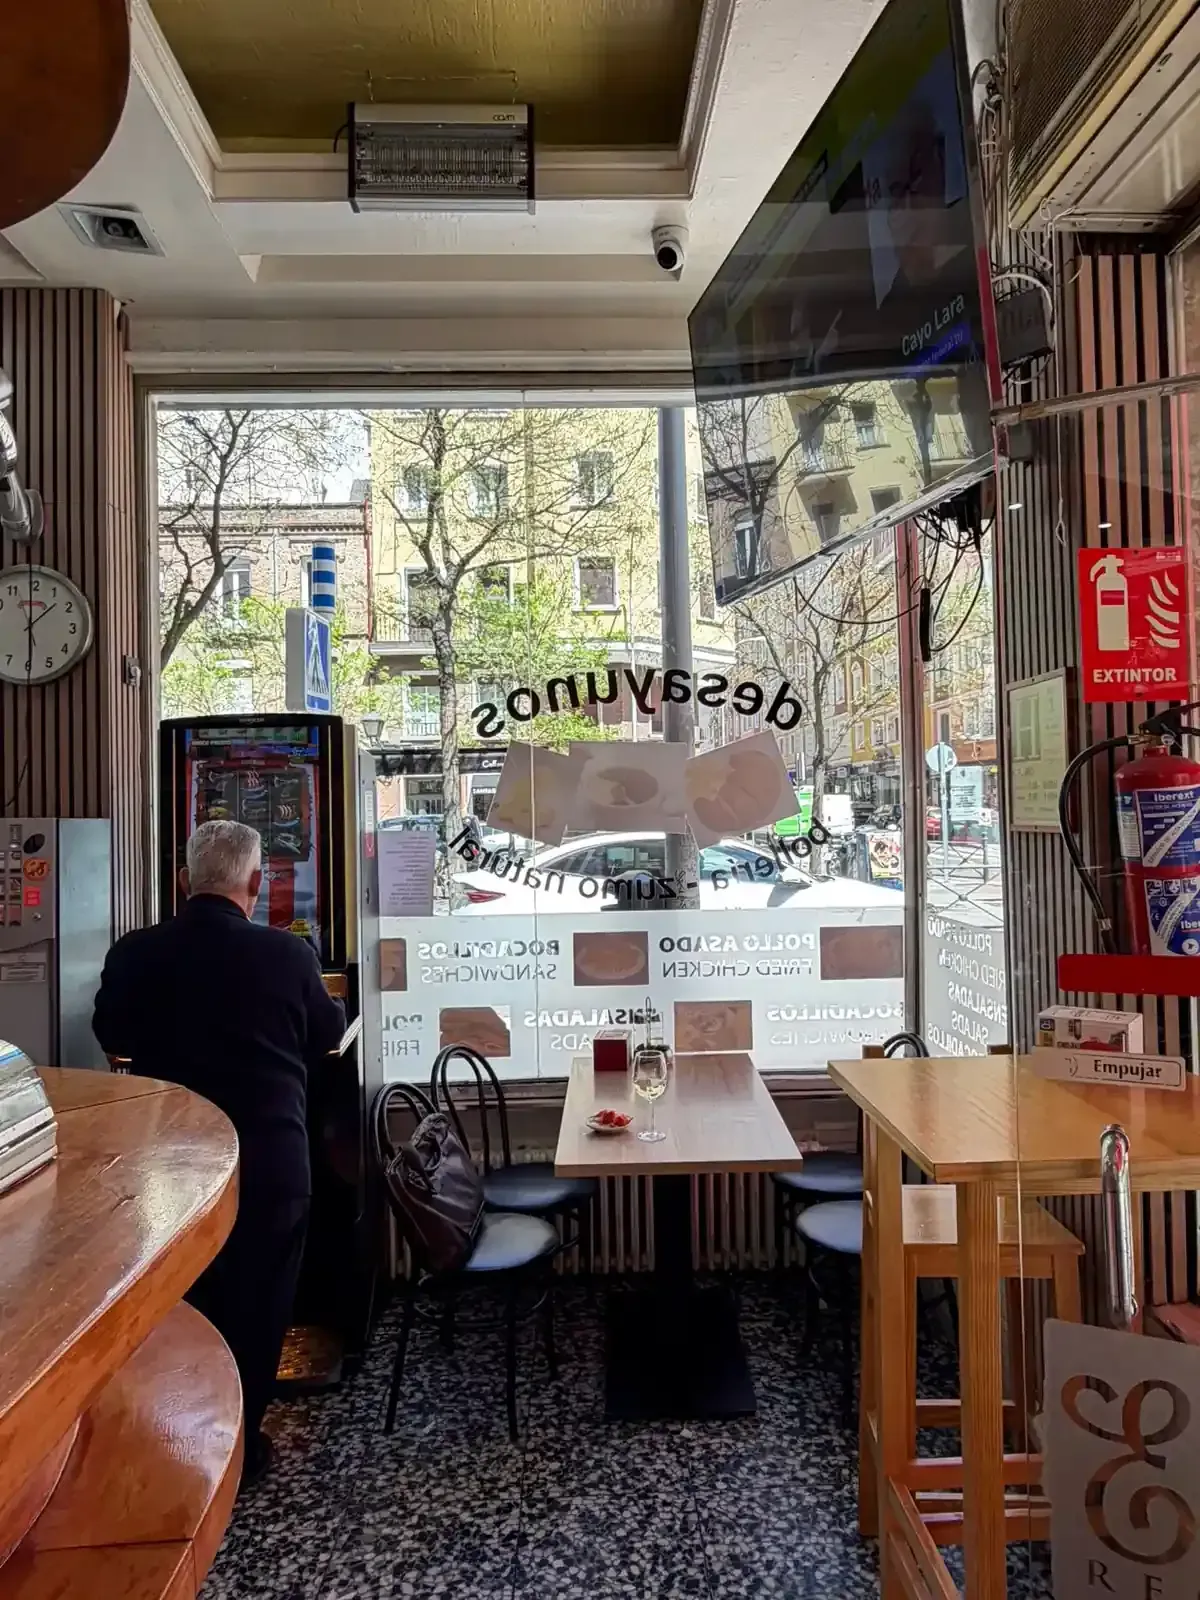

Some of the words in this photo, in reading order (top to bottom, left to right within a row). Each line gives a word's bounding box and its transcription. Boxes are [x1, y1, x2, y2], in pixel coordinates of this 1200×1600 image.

[901, 321, 932, 356] Cayo
[933, 293, 965, 331] Lara
[7, 585, 18, 596] 11
[52, 587, 57, 598] 1
[65, 601, 73, 613] 2
[69, 622, 77, 635] 3
[60, 643, 69, 655] 4
[5, 654, 13, 666] 7
[45, 657, 53, 669] 5
[1092, 667, 1177, 683] EXTINTOR
[1153, 790, 1195, 802] Iberext
[1093, 1059, 1162, 1081] Empujar
